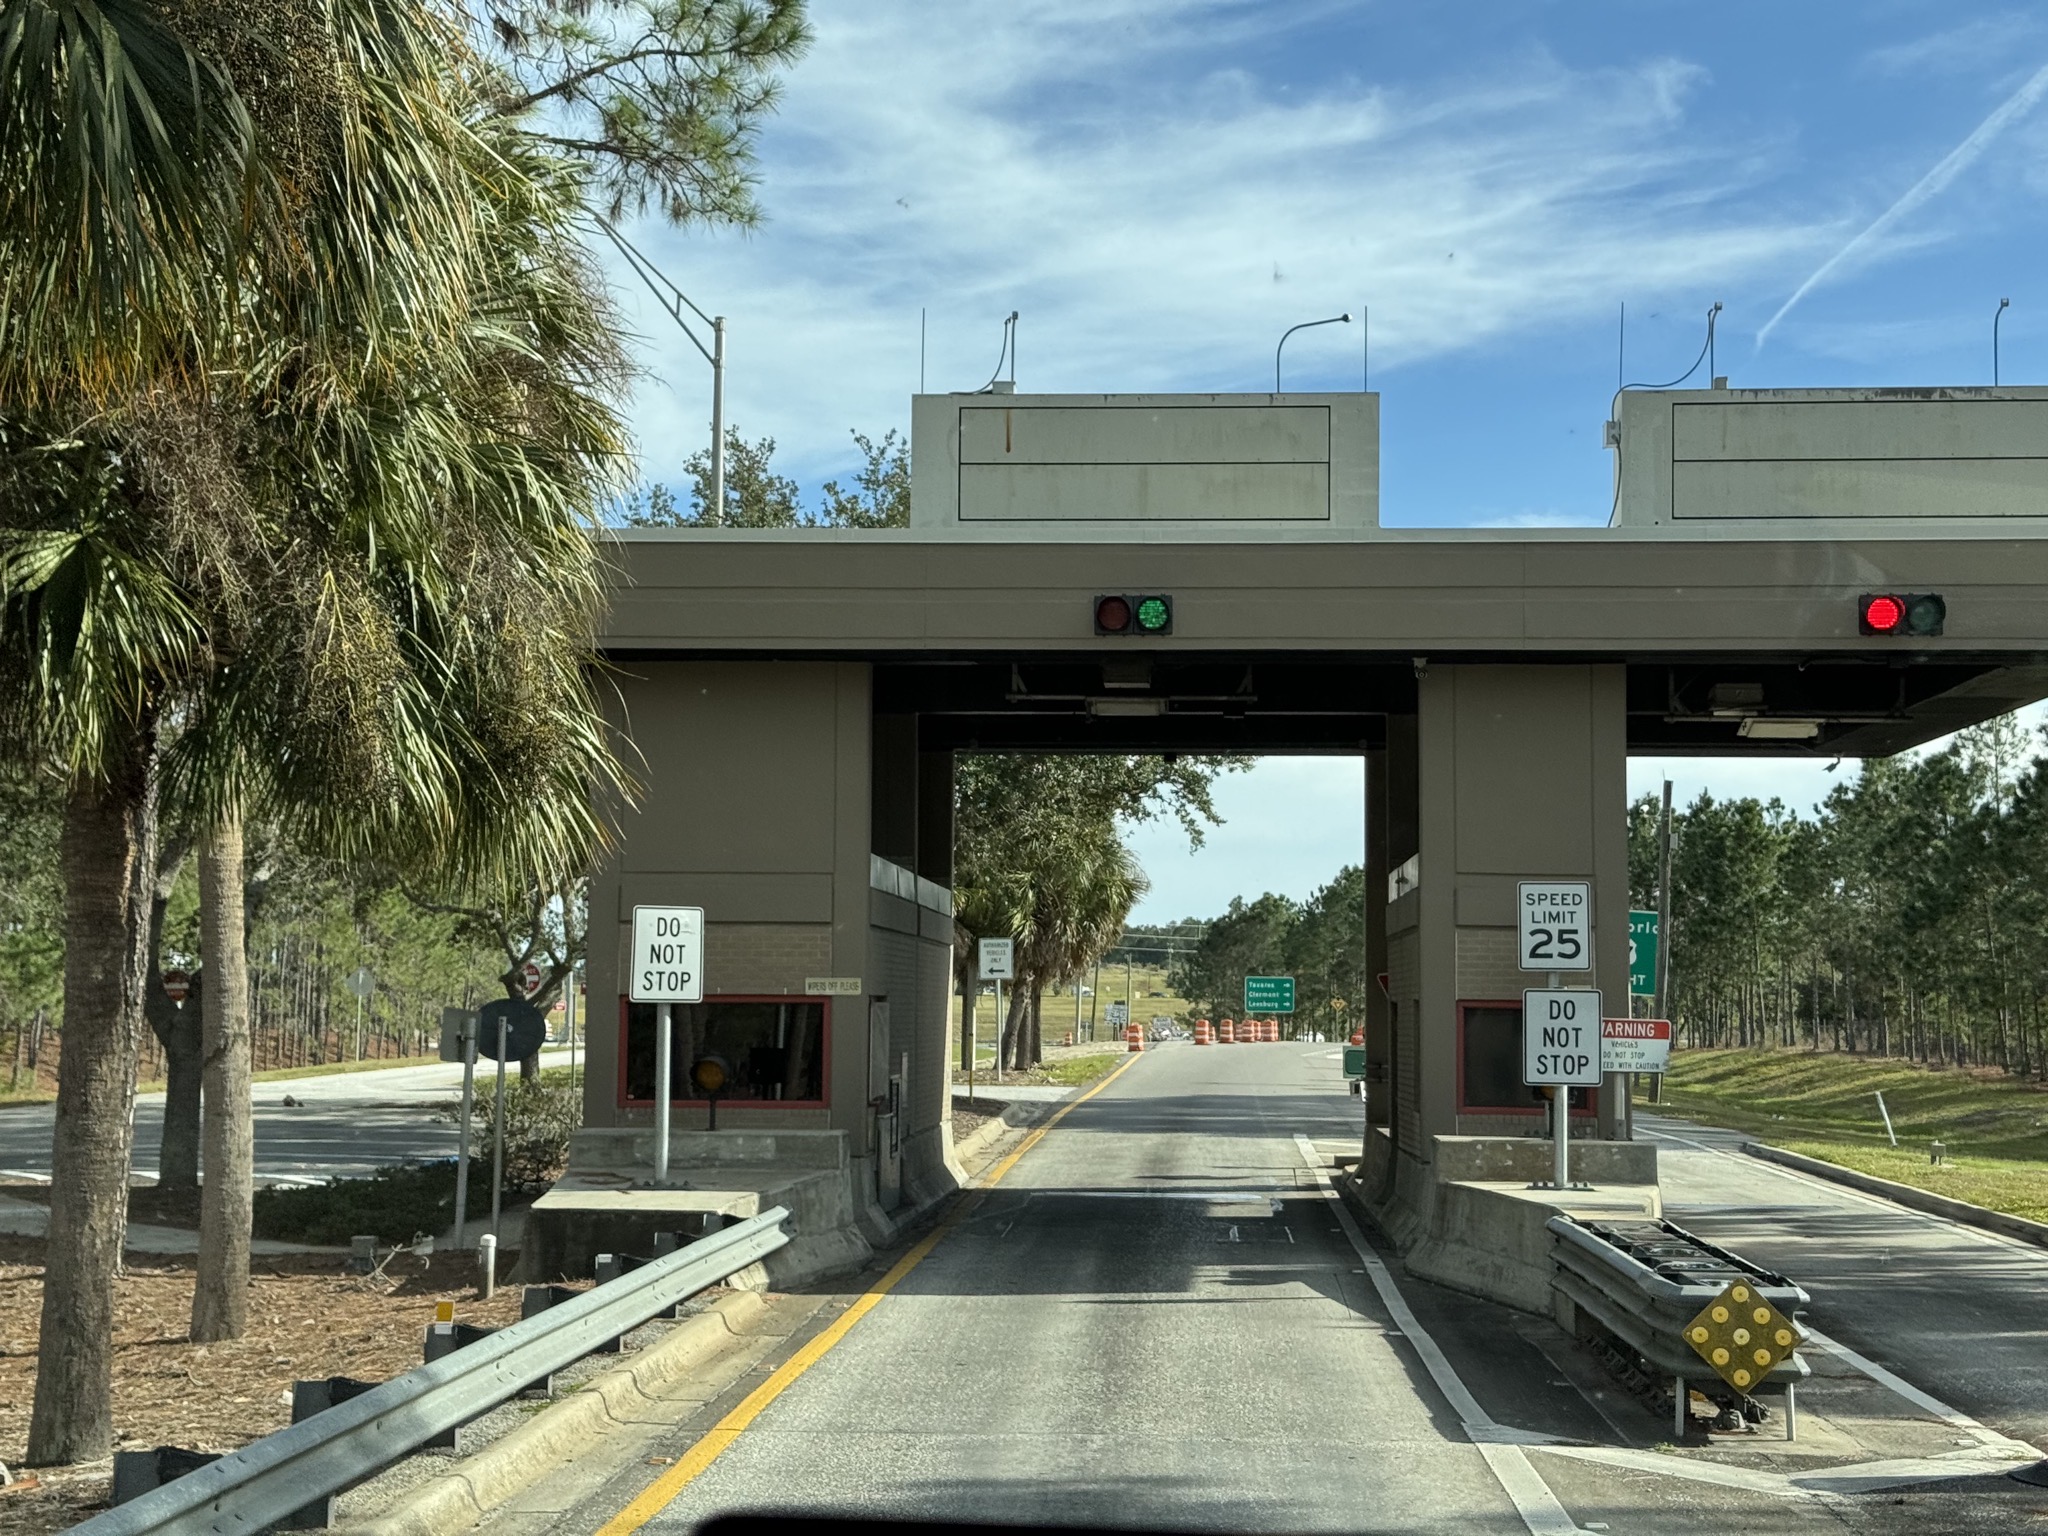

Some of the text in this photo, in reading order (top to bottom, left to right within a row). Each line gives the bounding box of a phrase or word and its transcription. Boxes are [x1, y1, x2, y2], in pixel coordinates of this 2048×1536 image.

[1525, 893, 1583, 906] SPEED
[657, 917, 680, 937] DO
[1531, 911, 1577, 924] LIMIT
[1528, 928, 1581, 959] 25
[650, 944, 686, 964] NOT
[642, 970, 691, 991] STOP
[1248, 1000, 1279, 1009] Leesburg
[1549, 999, 1576, 1020] DO
[1542, 1027, 1583, 1048] NOT
[1602, 1021, 1655, 1037] ARNING
[1536, 1054, 1590, 1075] STOP
[1602, 1051, 1646, 1059] DO NOT STOP
[1635, 1062, 1660, 1070] CAUTION
